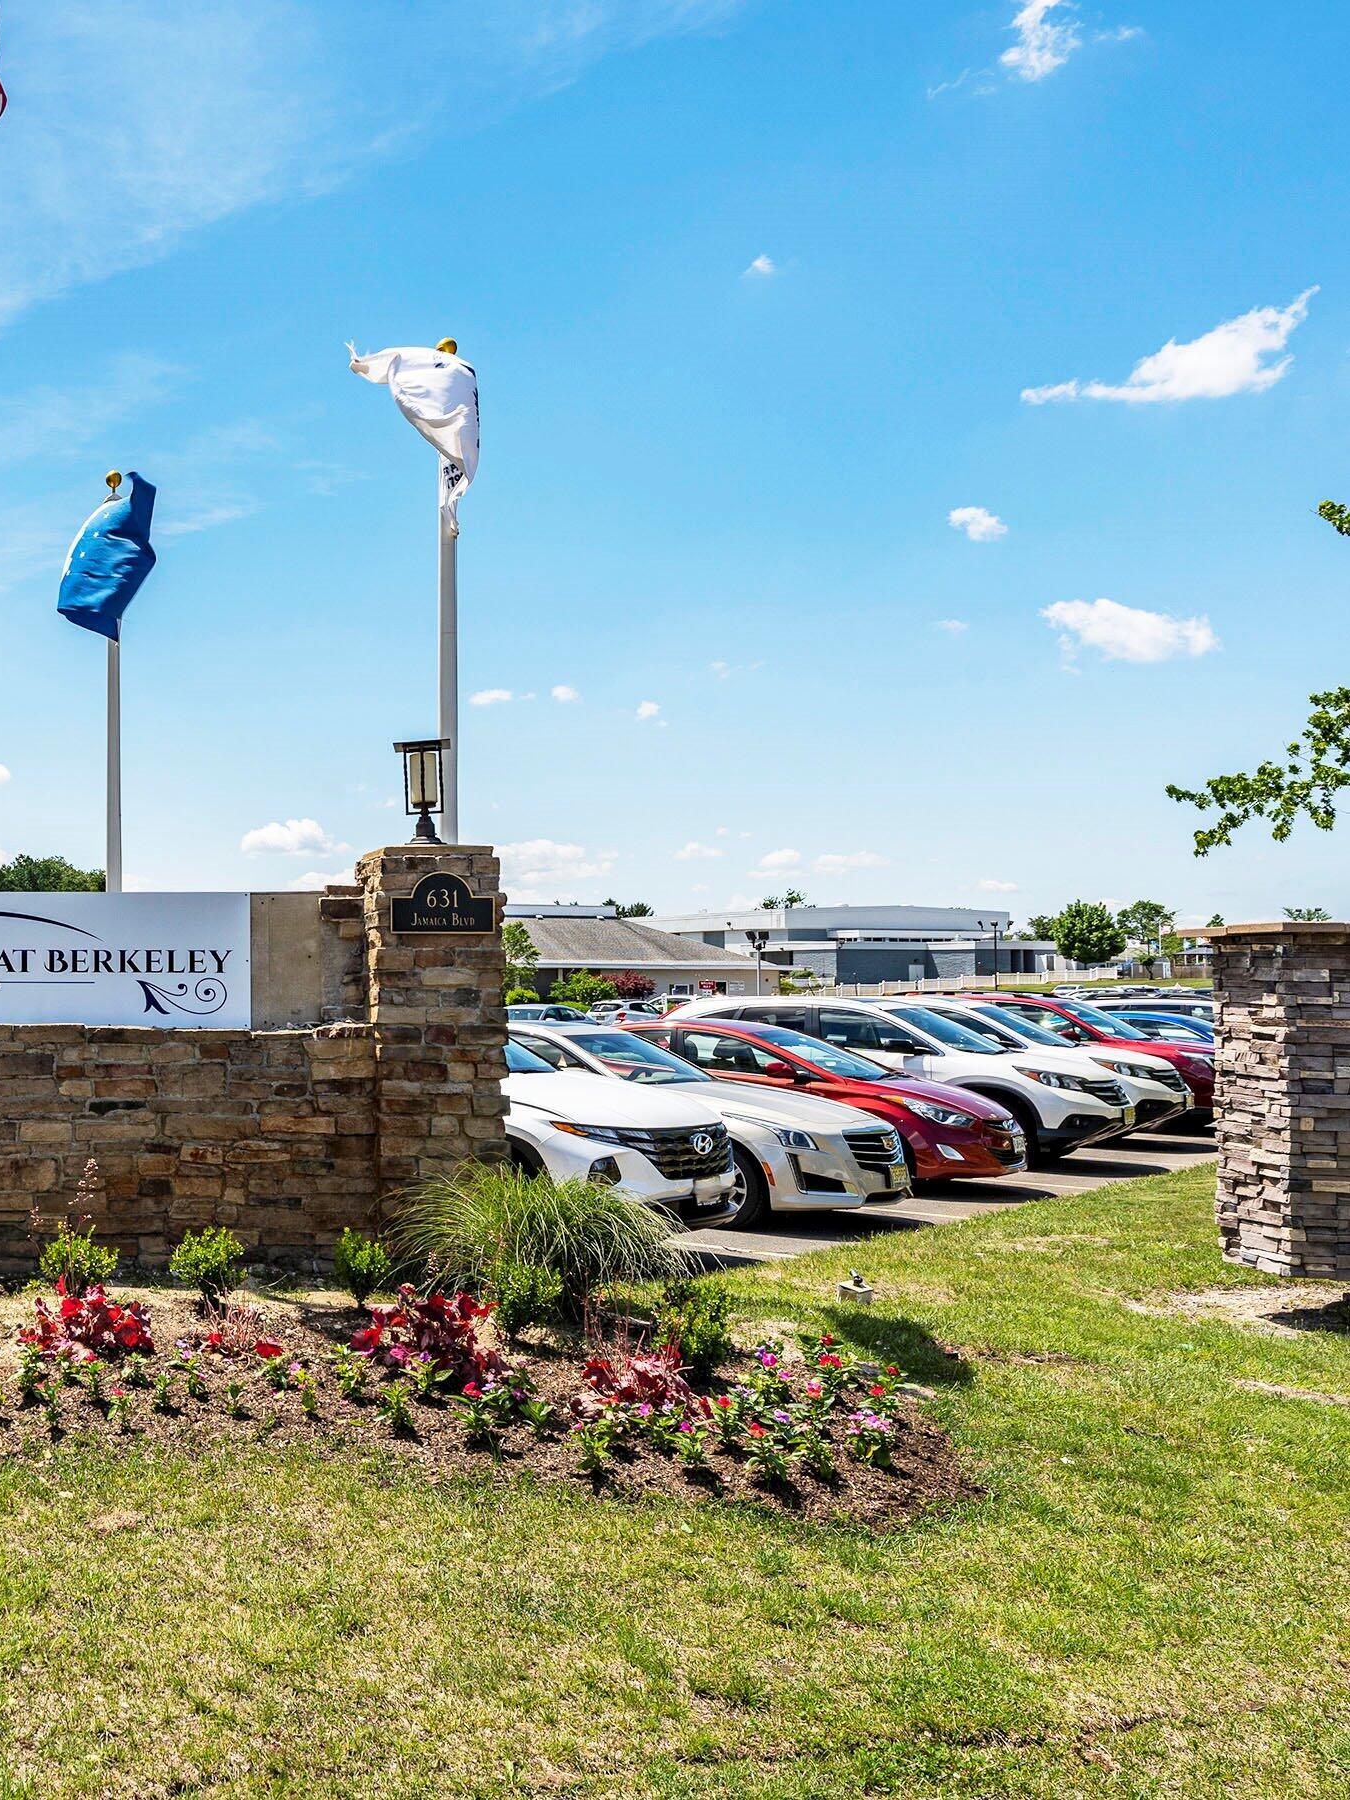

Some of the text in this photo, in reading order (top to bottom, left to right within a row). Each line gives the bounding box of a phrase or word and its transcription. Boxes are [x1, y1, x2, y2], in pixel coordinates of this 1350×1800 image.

[426, 888, 459, 908] 631
[411, 912, 475, 926] JAMAICA BLVD
[43, 949, 232, 973] BERKELEY
